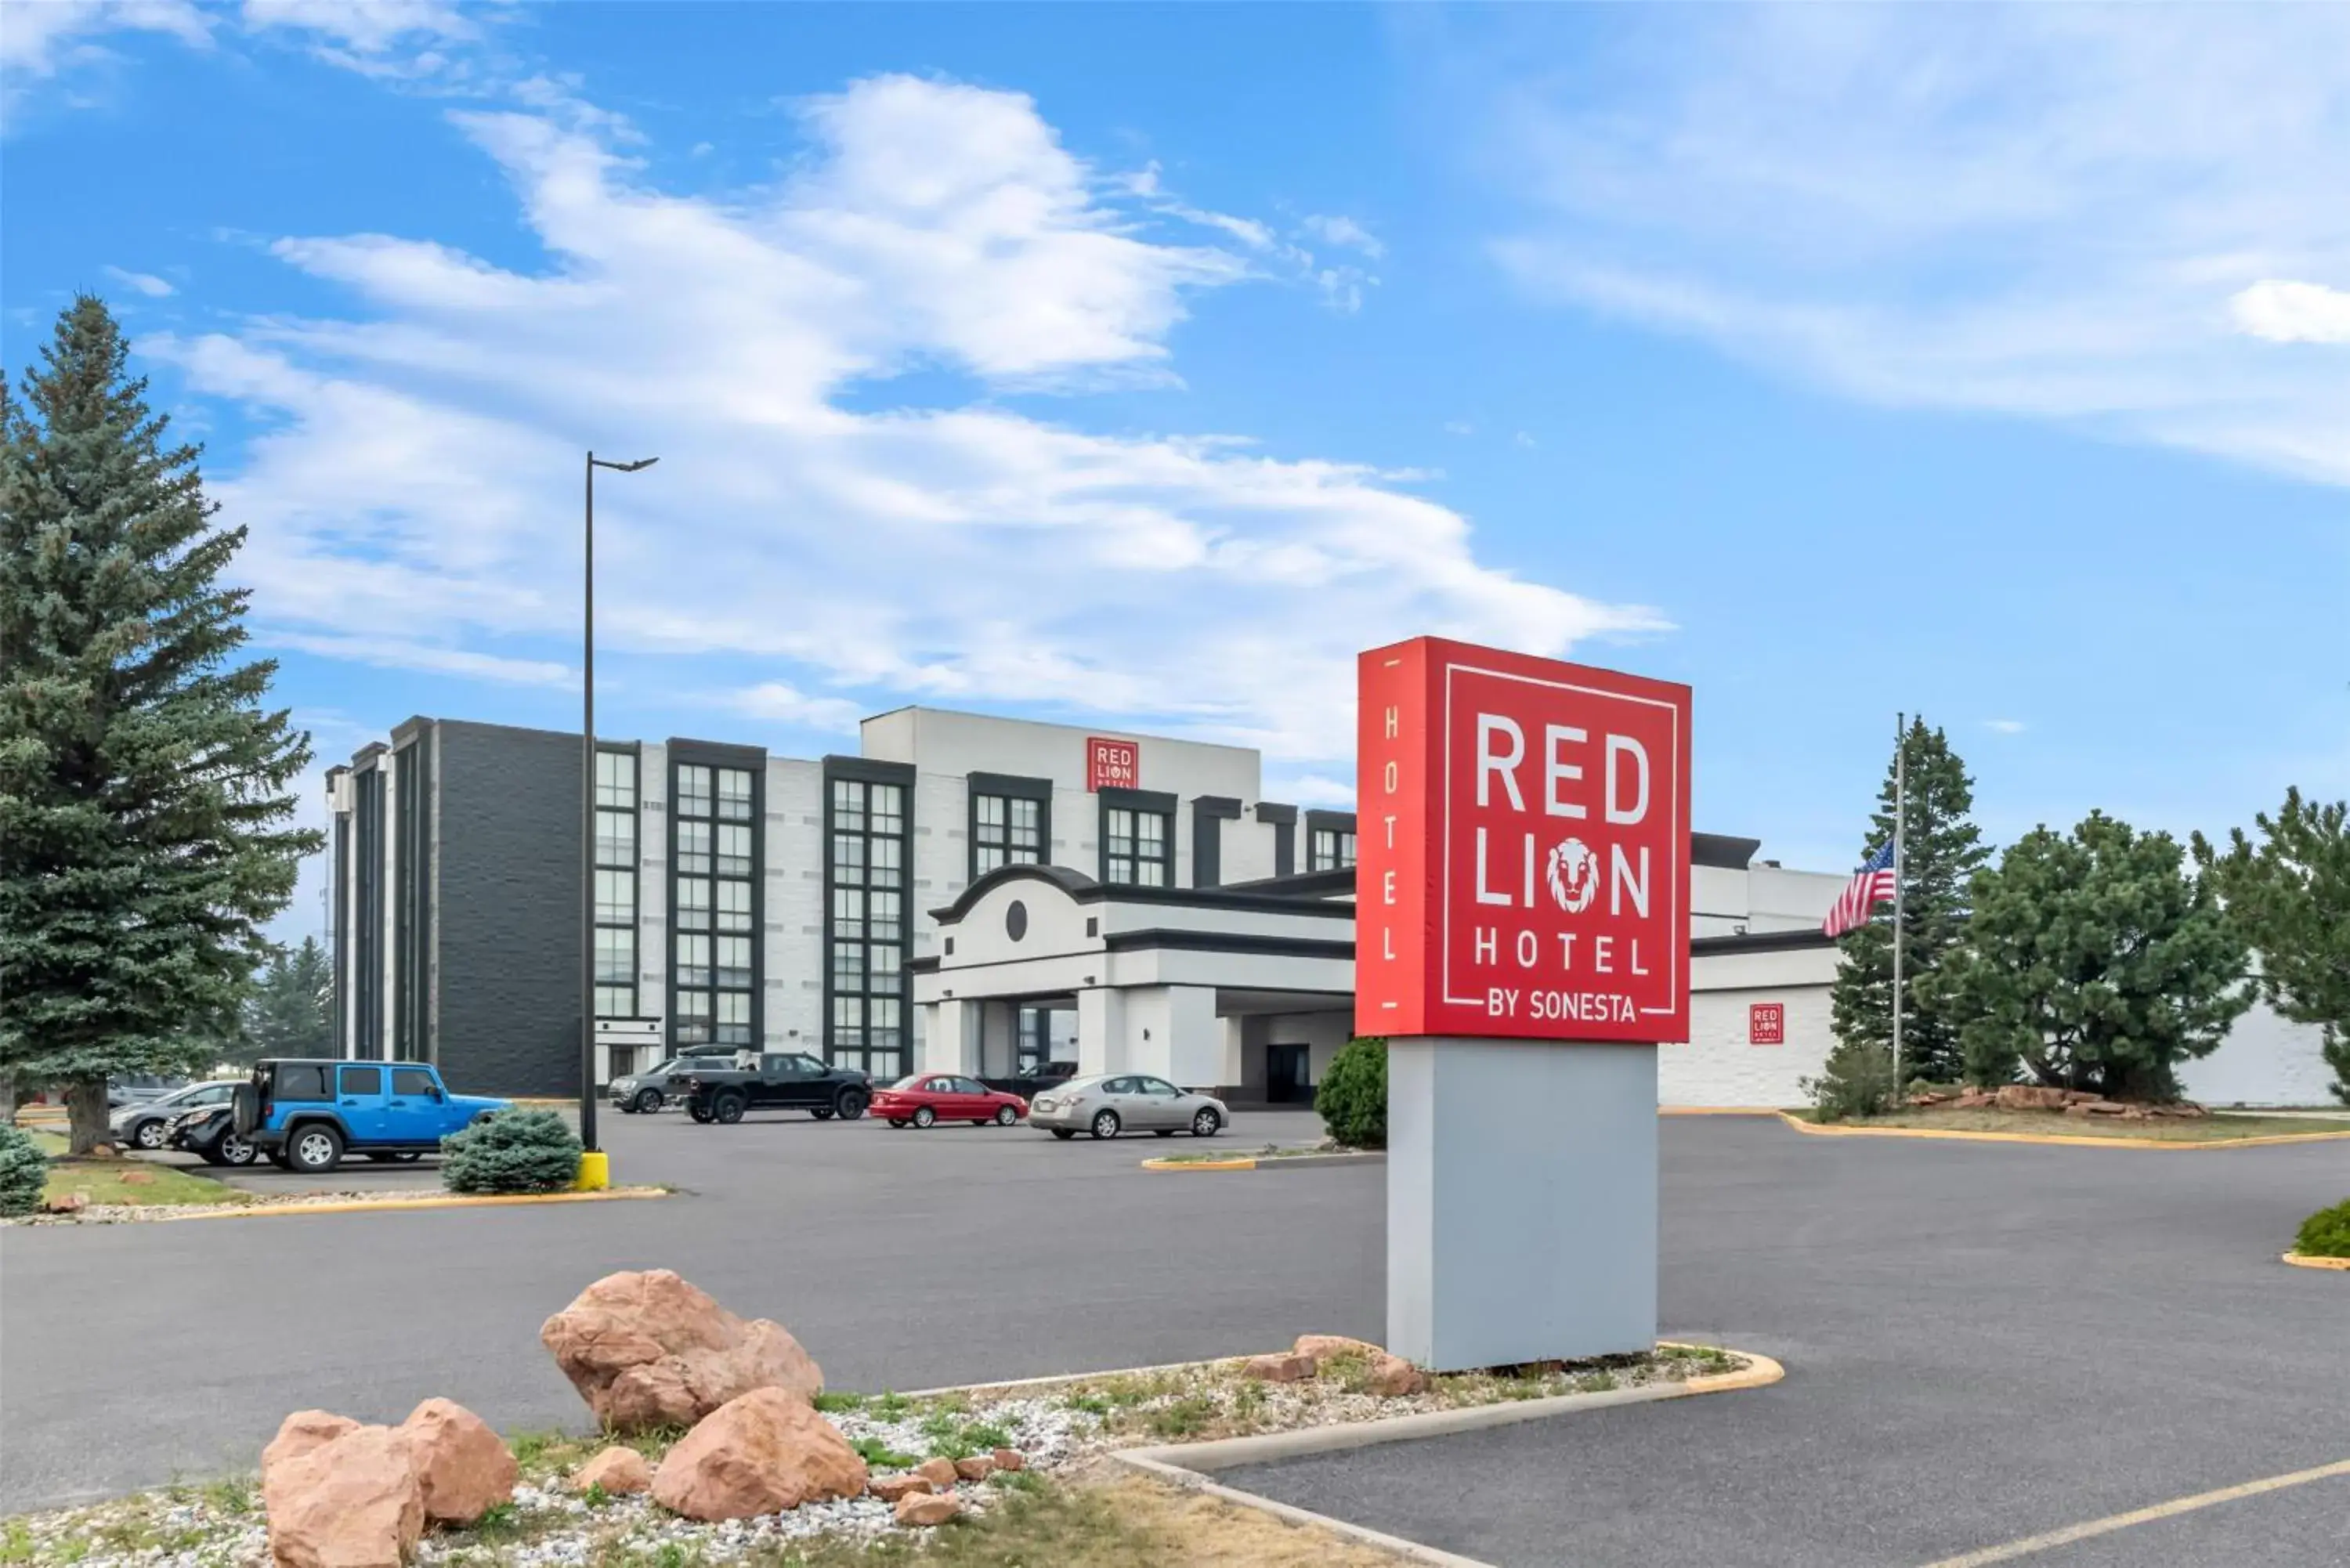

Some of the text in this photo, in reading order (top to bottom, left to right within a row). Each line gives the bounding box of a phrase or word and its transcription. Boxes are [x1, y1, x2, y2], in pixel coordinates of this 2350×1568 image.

[1097, 747, 1131, 765] RED
[1097, 764, 1131, 779] LION
[1477, 712, 1650, 825] RED
[1384, 706, 1398, 959] HOTEL
[1476, 827, 1650, 919] LION
[1475, 927, 1649, 975] HOTEL
[1488, 988, 1636, 1022] BY SONESTA
[1755, 1010, 1777, 1021] RED
